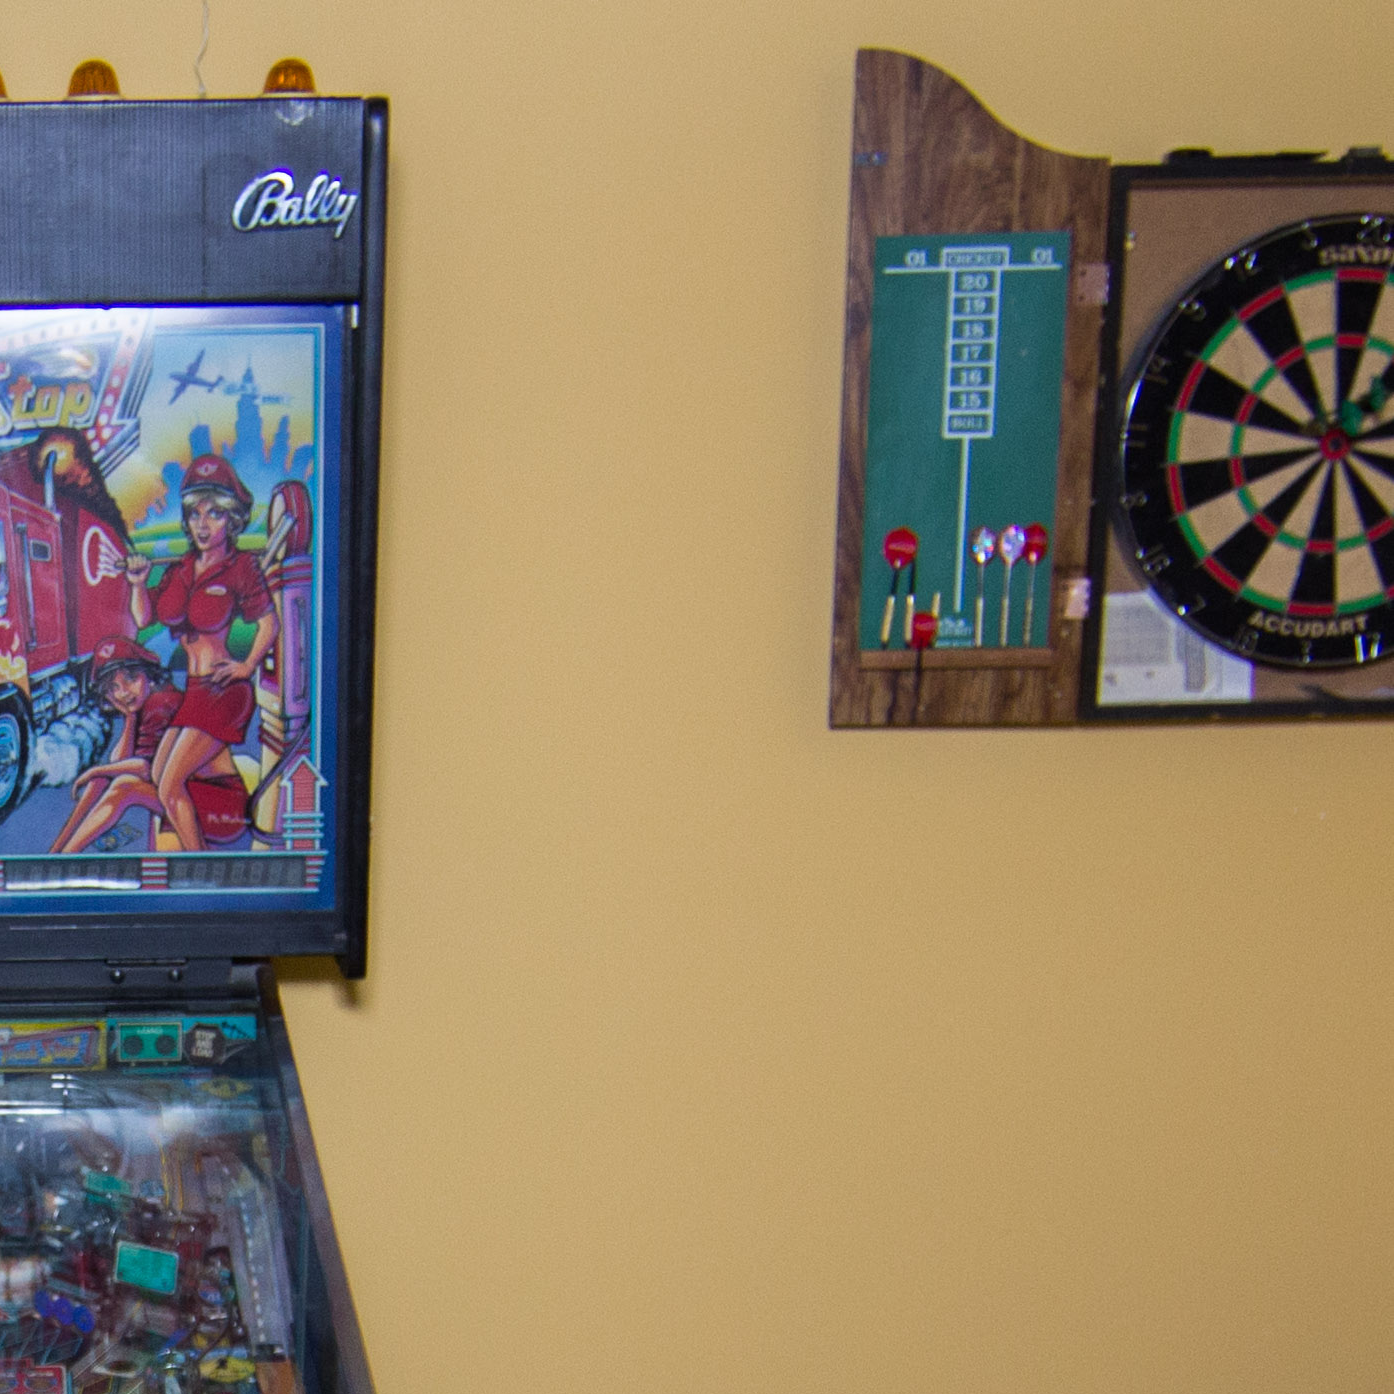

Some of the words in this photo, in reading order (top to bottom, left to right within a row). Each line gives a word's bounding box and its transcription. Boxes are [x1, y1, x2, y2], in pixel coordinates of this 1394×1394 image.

[232, 170, 357, 238] Bally
[961, 274, 988, 289] 20
[963, 299, 986, 312] 19
[962, 324, 985, 337] 18
[961, 346, 983, 361] 17
[960, 369, 982, 384] 16
[960, 394, 981, 408] 15
[951, 417, 983, 428] BULL
[1249, 611, 1368, 637] ACCUDART
